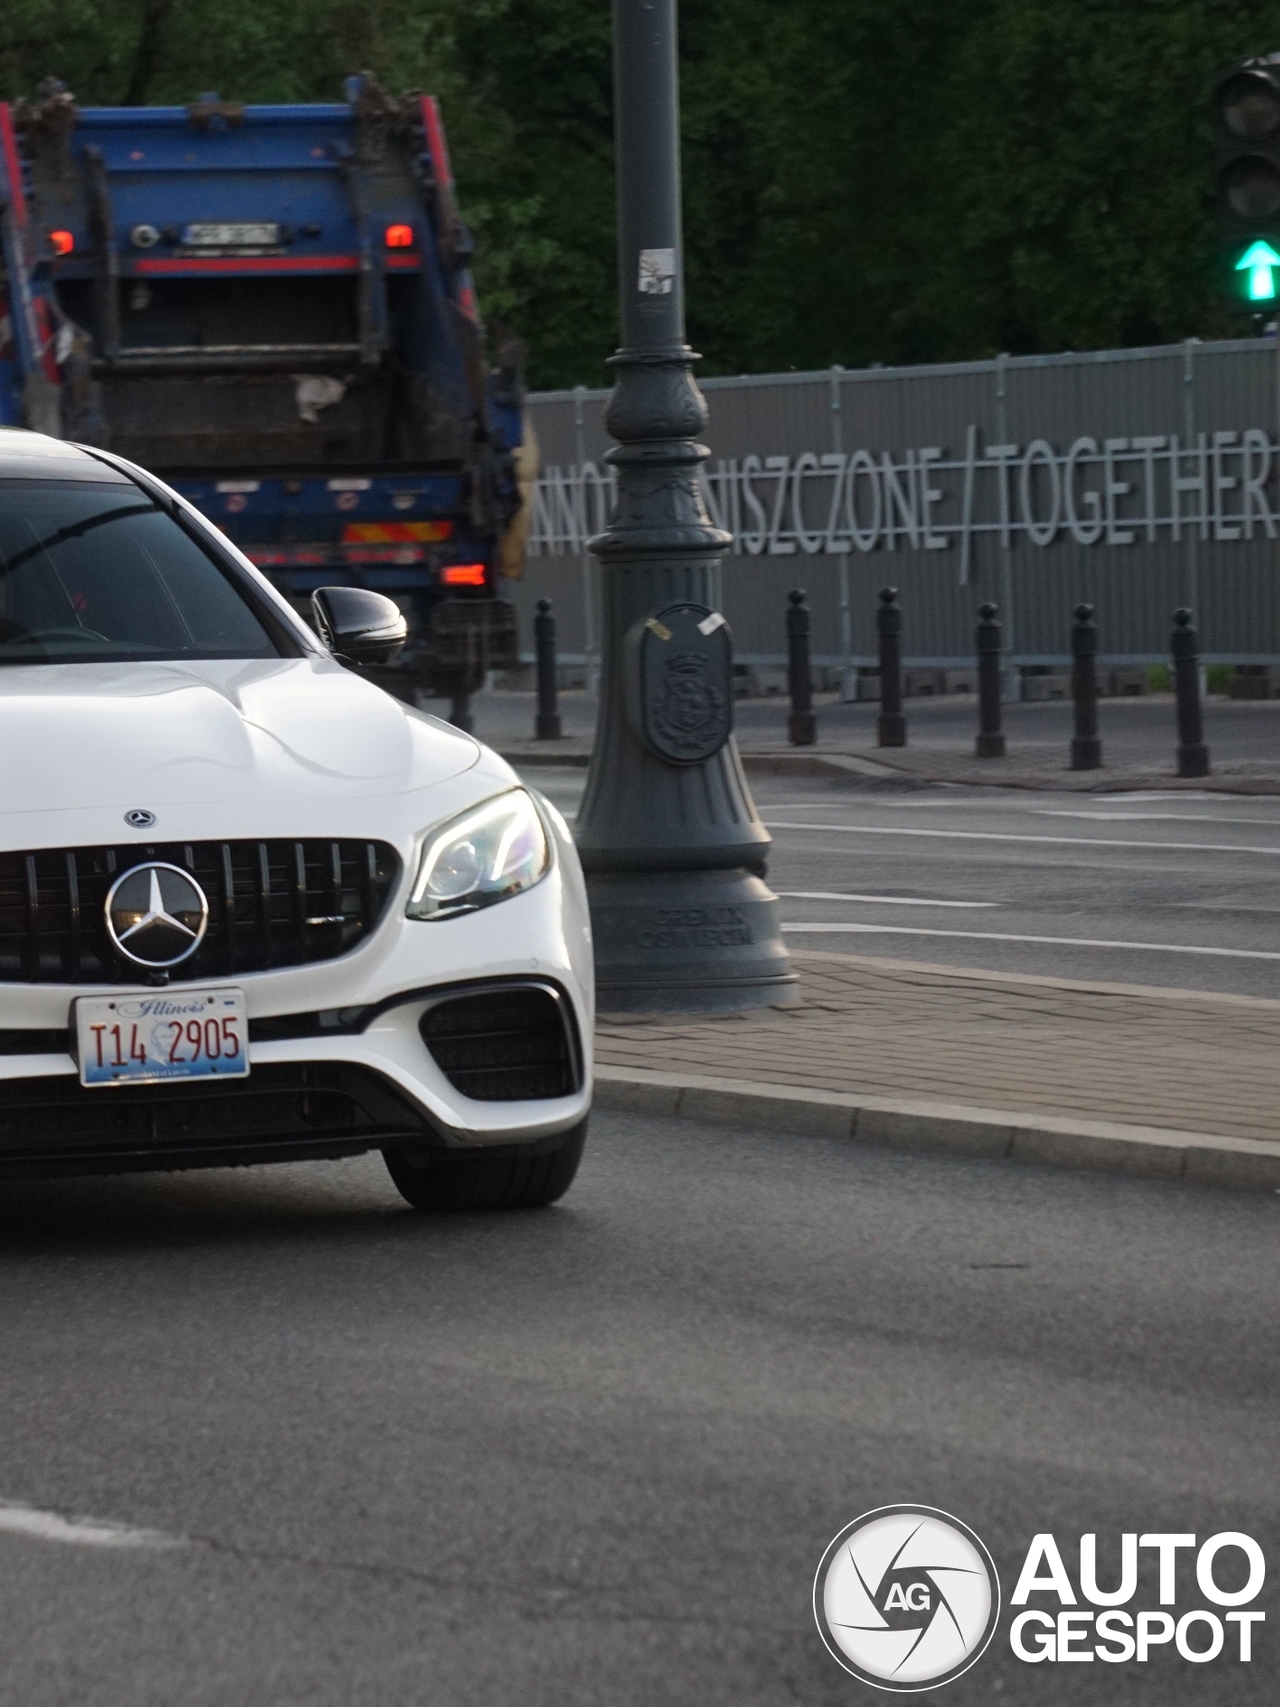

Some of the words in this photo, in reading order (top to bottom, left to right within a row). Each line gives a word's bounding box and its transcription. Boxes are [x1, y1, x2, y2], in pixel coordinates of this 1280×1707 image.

[984, 429, 1277, 547] TOGETHER
[117, 999, 206, 1018] Illinois
[90, 1022, 147, 1067] T14
[168, 1017, 239, 1063] 2905
